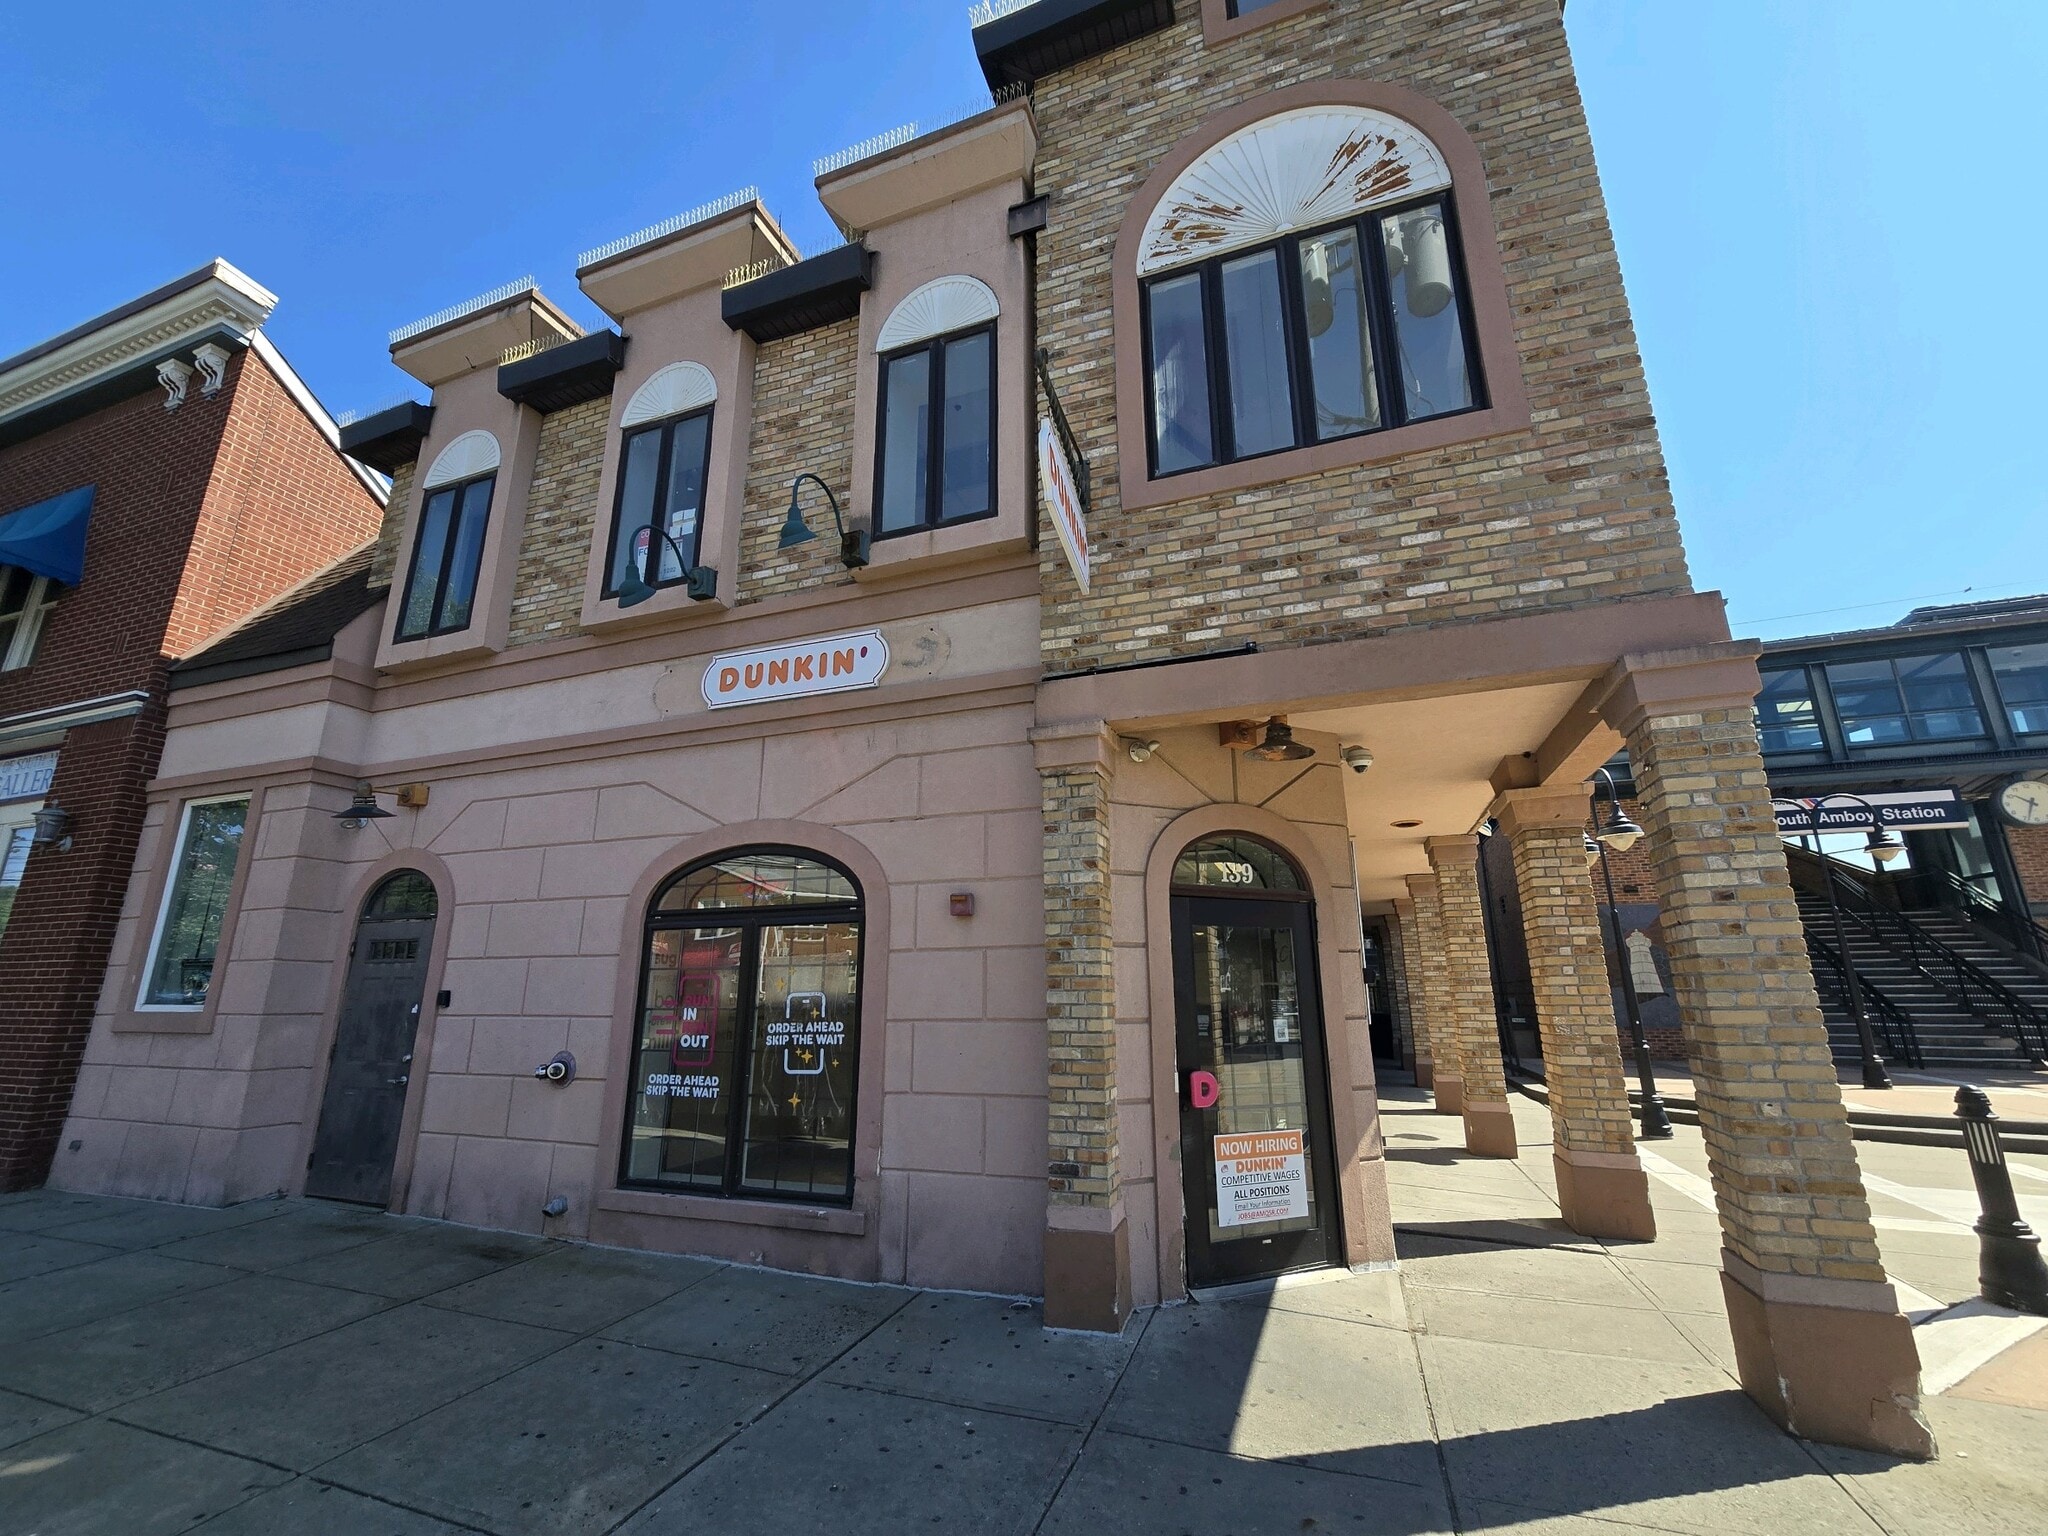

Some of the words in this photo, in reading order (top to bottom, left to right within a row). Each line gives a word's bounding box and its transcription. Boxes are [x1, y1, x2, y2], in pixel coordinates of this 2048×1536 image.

[719, 646, 868, 693] DUNKIN'
[1777, 813, 1812, 826] outh
[1818, 810, 1875, 824] Amboy
[1881, 806, 1946, 821] Station
[683, 1007, 697, 1020] IN
[767, 1022, 803, 1033] ORDER
[805, 1021, 844, 1033] AHEAD
[680, 1034, 709, 1048] OUT
[765, 1034, 789, 1046] SKIP
[791, 1034, 813, 1045] THE
[816, 1034, 845, 1045] WAIT
[648, 1073, 681, 1085] ORDER
[683, 1075, 719, 1086] AHEAD
[646, 1084, 668, 1096] SKIP
[670, 1086, 690, 1097] THE
[692, 1087, 720, 1098] WAIT
[1190, 1070, 1219, 1108] D
[1221, 1141, 1252, 1156] NOW
[1256, 1137, 1298, 1153] HIRING
[1236, 1157, 1287, 1173] DUNKIN'
[1221, 1172, 1271, 1186] COMPETITIVE
[1273, 1169, 1300, 1180] WAGES
[1234, 1190, 1247, 1199] ALL
[1249, 1185, 1290, 1197] POSITIONS
[1250, 1201, 1260, 1209] Your
[1262, 1199, 1291, 1207] Information
